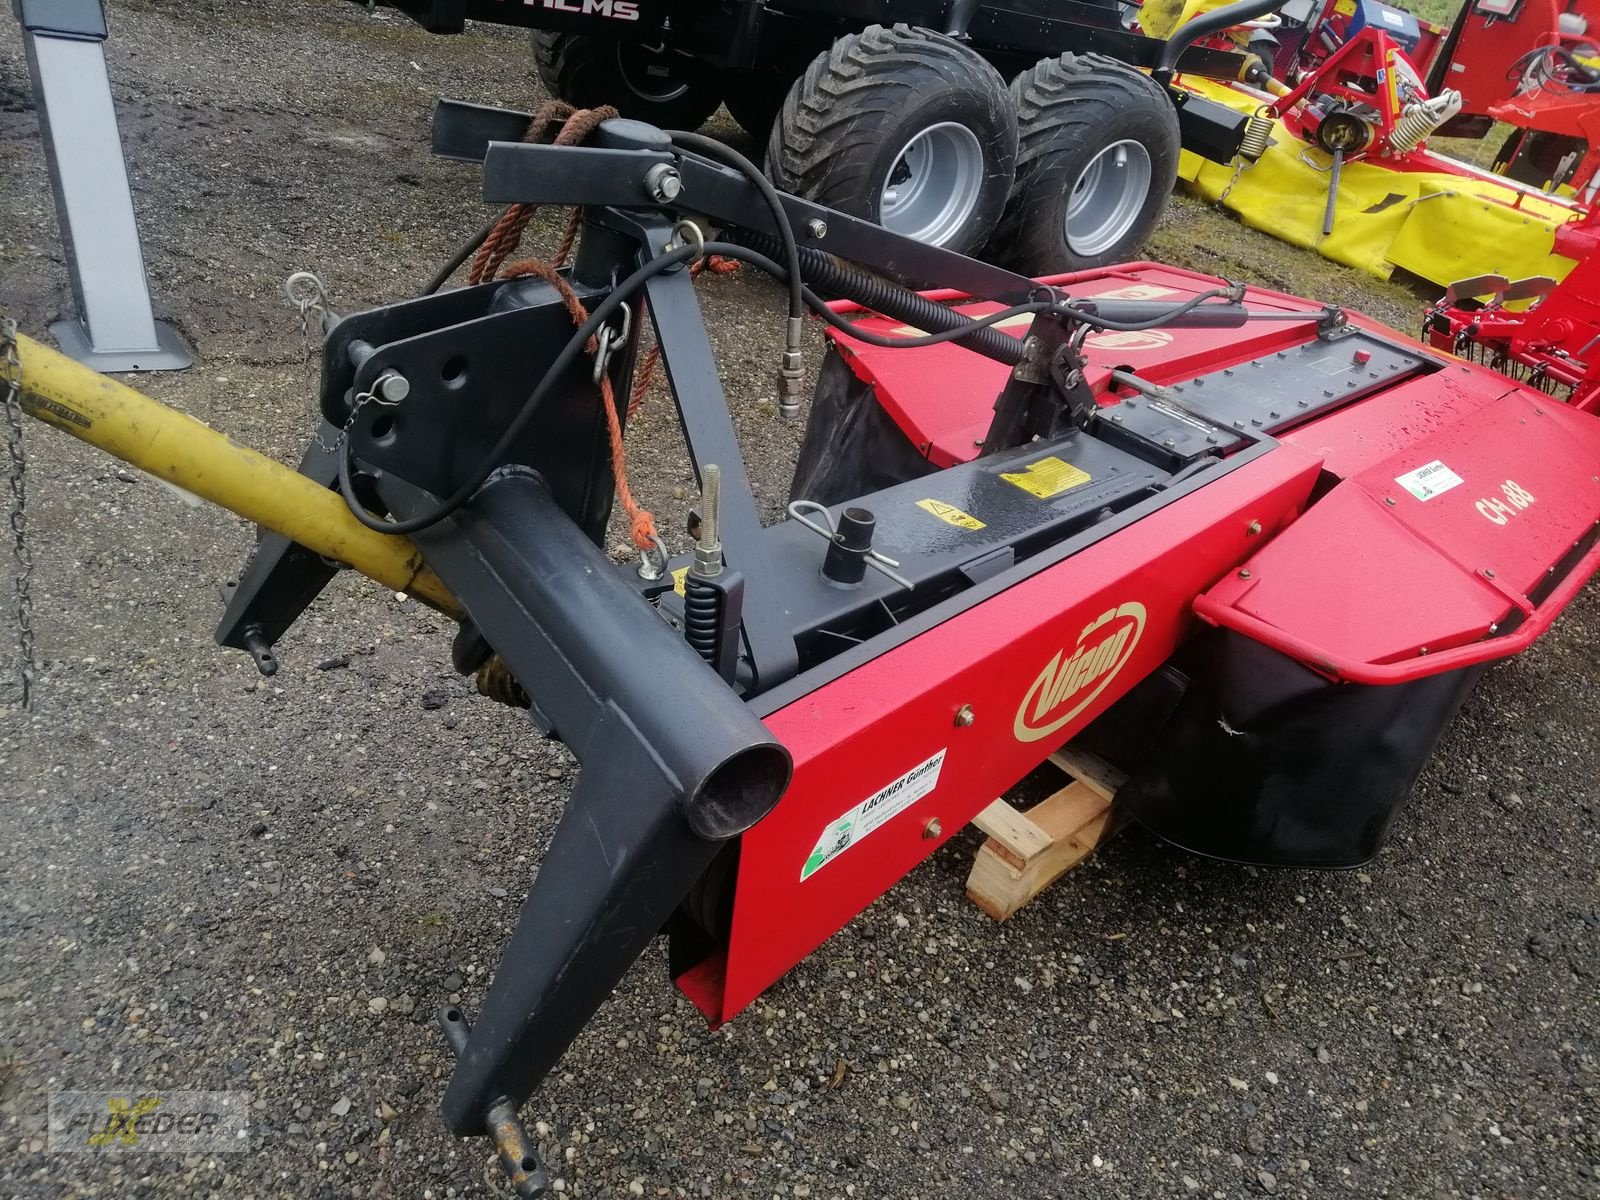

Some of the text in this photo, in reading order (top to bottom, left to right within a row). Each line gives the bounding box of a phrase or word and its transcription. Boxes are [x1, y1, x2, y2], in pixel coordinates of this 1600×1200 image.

[497, 0, 640, 21] LMS
[1474, 479, 1536, 526] CM 188
[1031, 621, 1134, 724] Vicon
[861, 778, 905, 815] LACHNER
[906, 756, 943, 785] Günther
